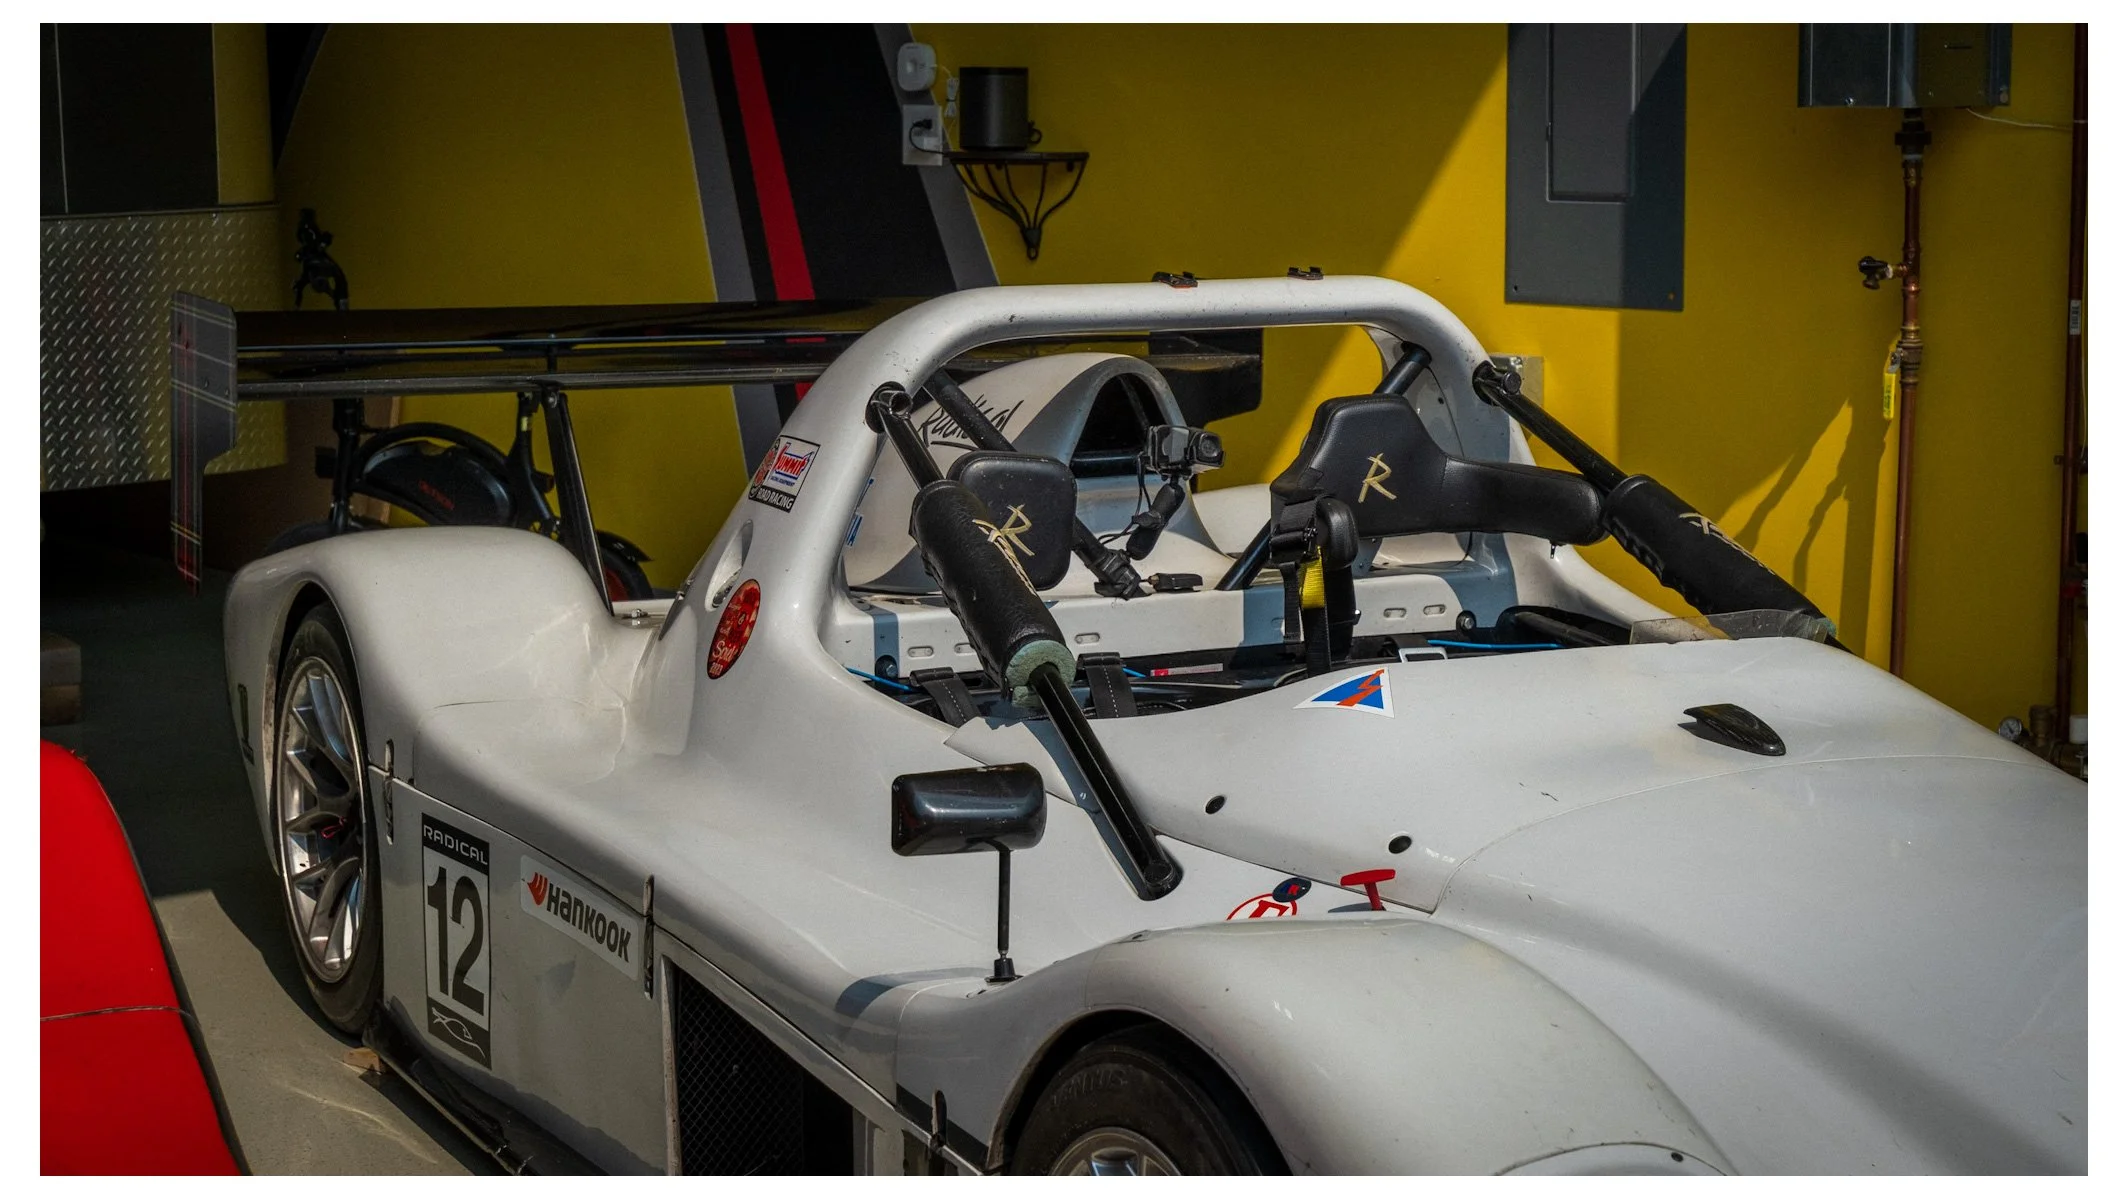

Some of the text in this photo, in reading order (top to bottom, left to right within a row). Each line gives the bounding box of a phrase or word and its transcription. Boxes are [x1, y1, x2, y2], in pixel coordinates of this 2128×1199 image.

[773, 441, 811, 478] SUMMIT
[1357, 453, 1398, 503] R
[769, 491, 794, 509] RACING
[423, 824, 488, 866] RADICAL
[427, 866, 485, 1016] 12
